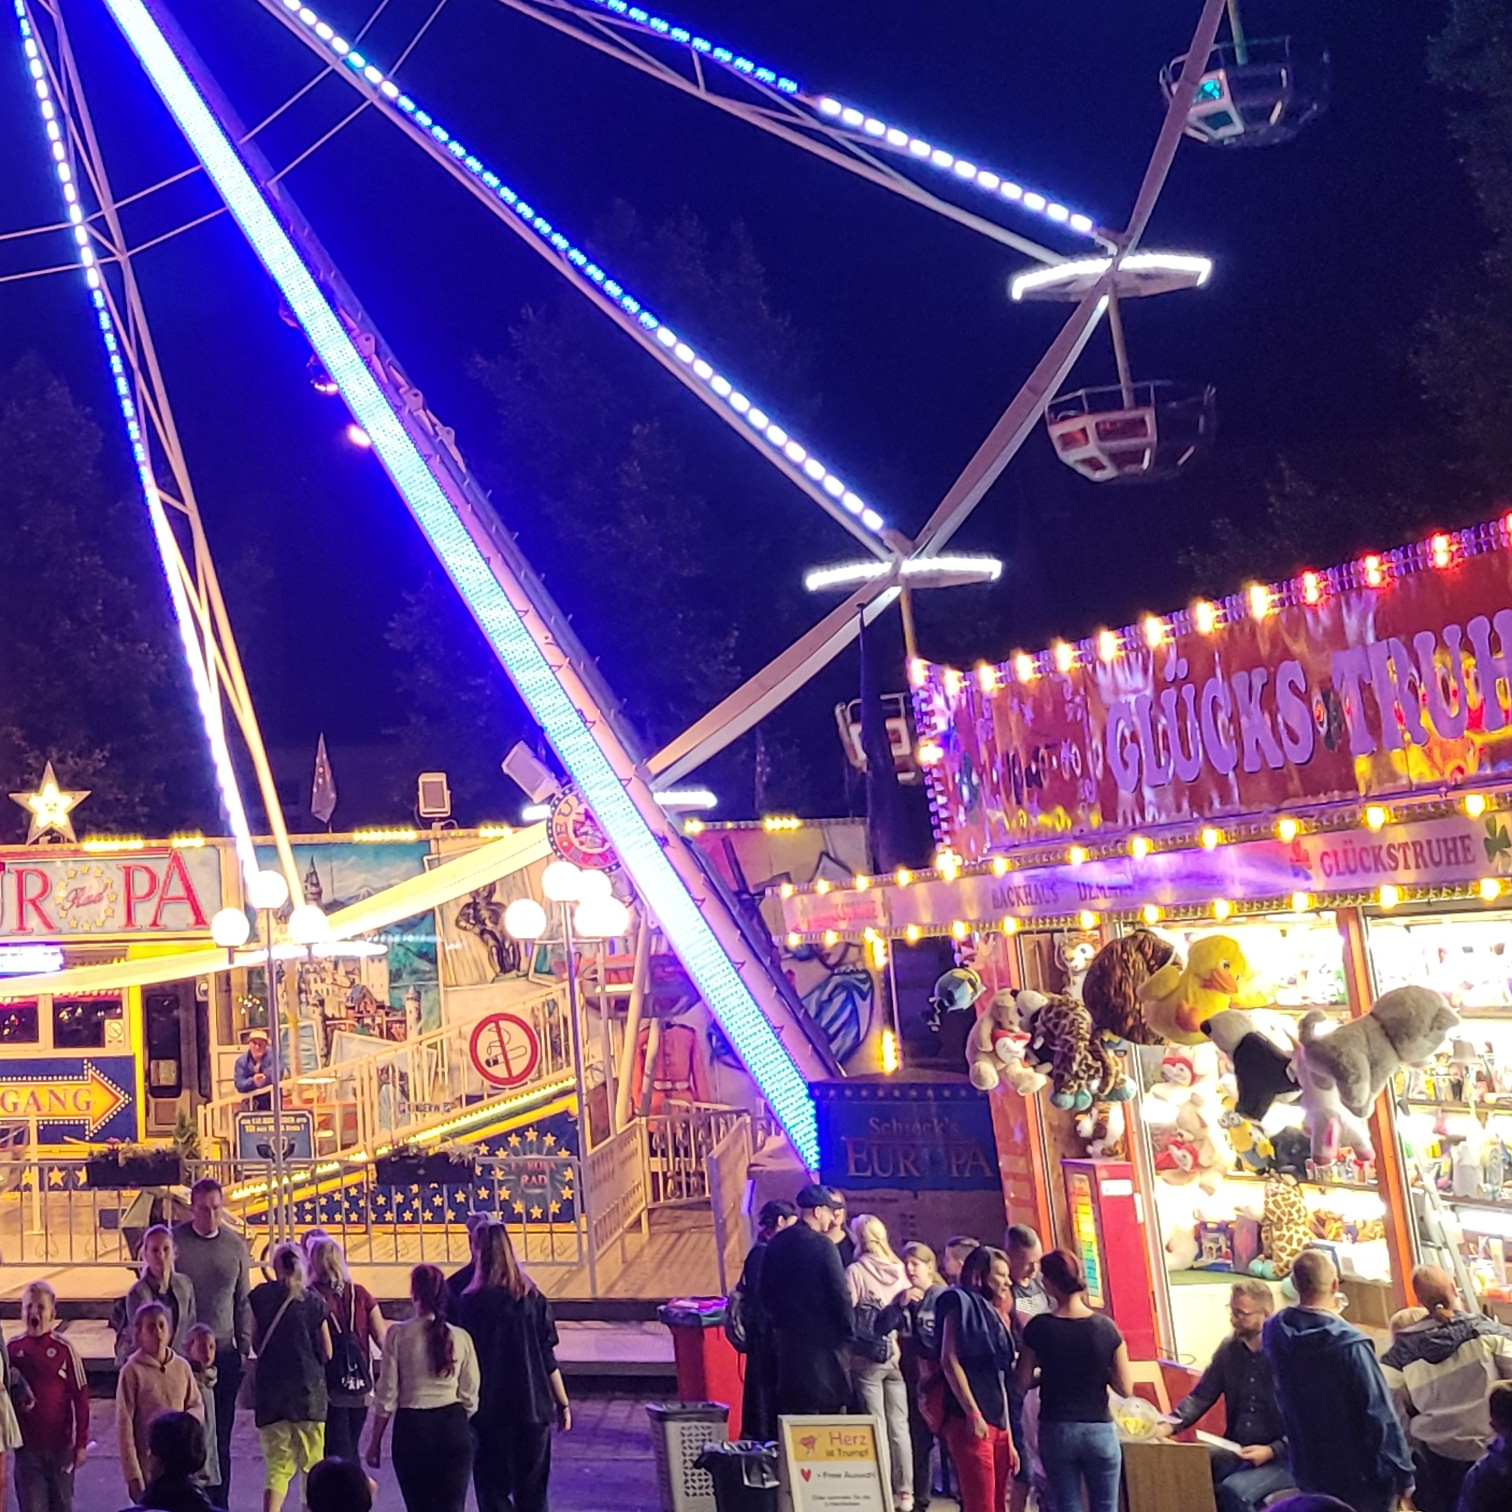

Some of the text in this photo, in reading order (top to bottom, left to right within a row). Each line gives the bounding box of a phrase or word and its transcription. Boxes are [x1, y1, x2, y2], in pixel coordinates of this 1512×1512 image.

[1107, 654, 1315, 793] GLÜCKS
[1319, 834, 1476, 878] GLÜCKSTRUHE
[868, 1117, 960, 1135] Schieck's
[521, 1174, 548, 1185] RAD
[829, 1431, 868, 1446] Herz
